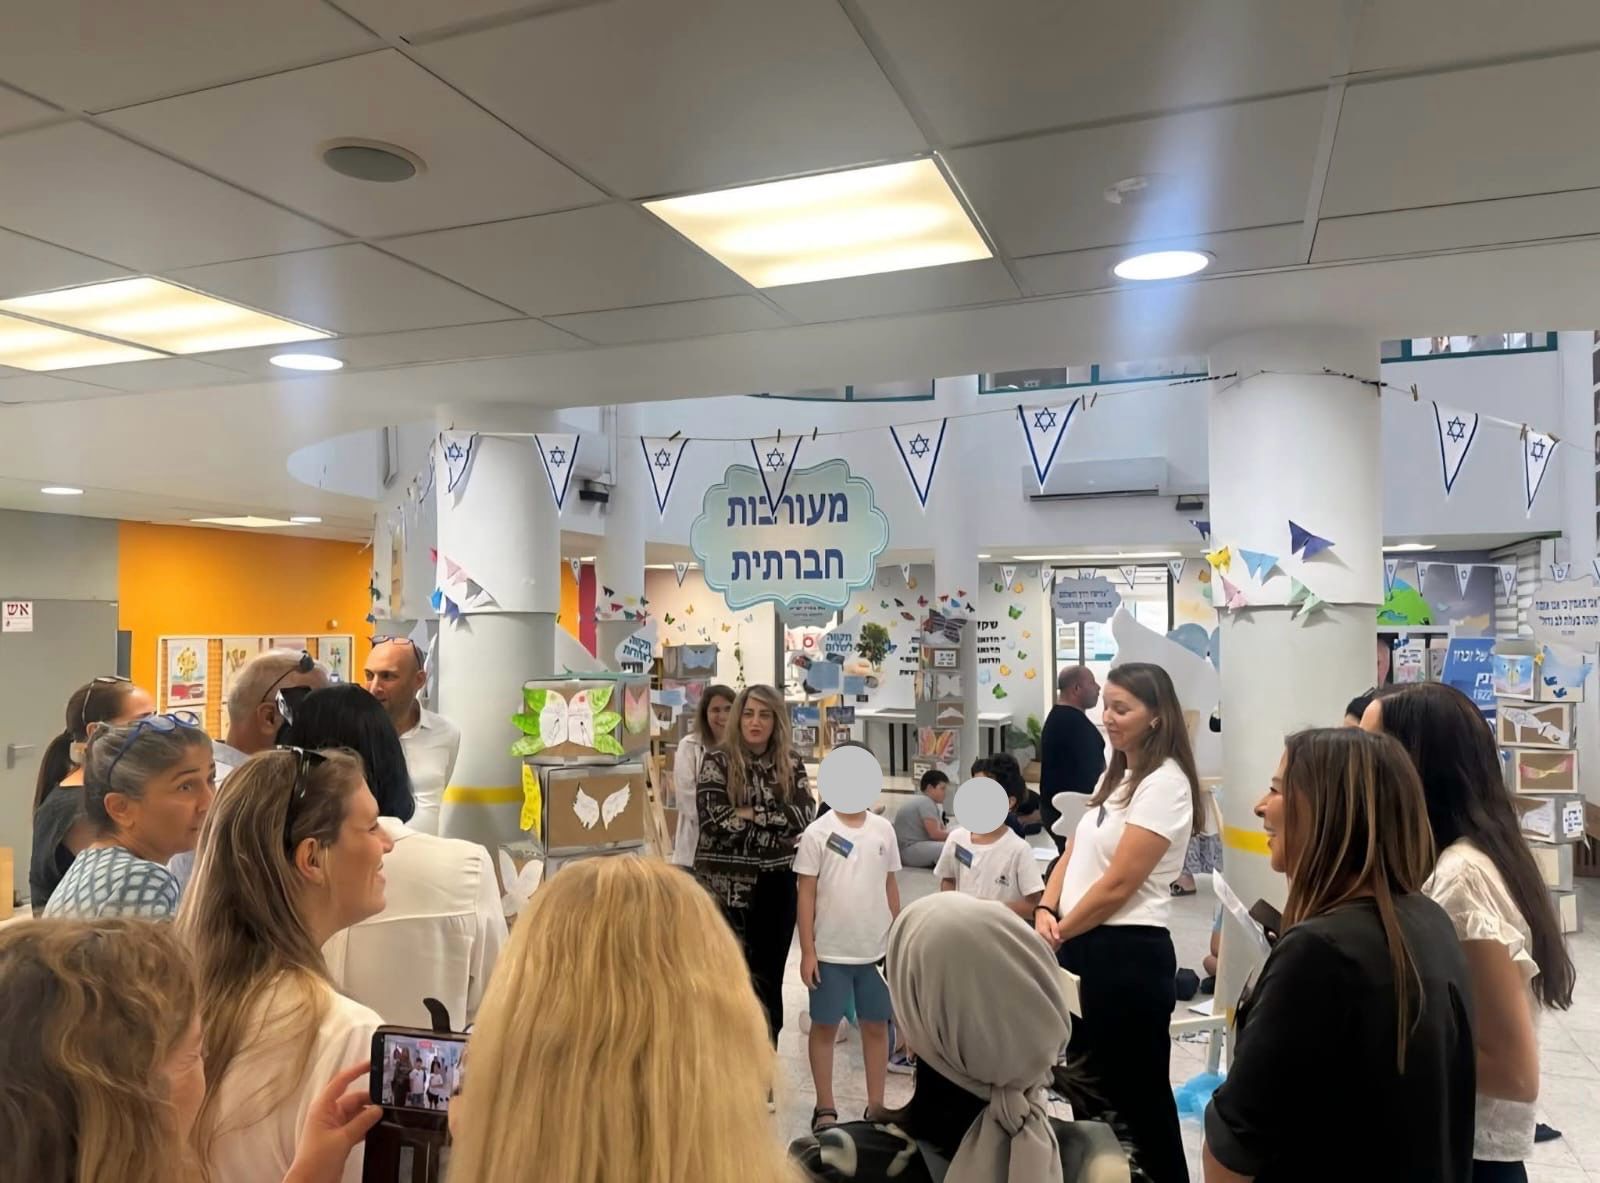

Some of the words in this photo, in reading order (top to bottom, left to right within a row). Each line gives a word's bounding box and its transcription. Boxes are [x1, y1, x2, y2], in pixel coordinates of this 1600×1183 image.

[731, 548, 844, 581] חברתית
[7, 603, 29, 616] אש
[629, 635, 652, 650] תקווה
[827, 633, 852, 642] תקווה
[826, 642, 853, 652] לשלום
[623, 645, 652, 664] לאחדות
